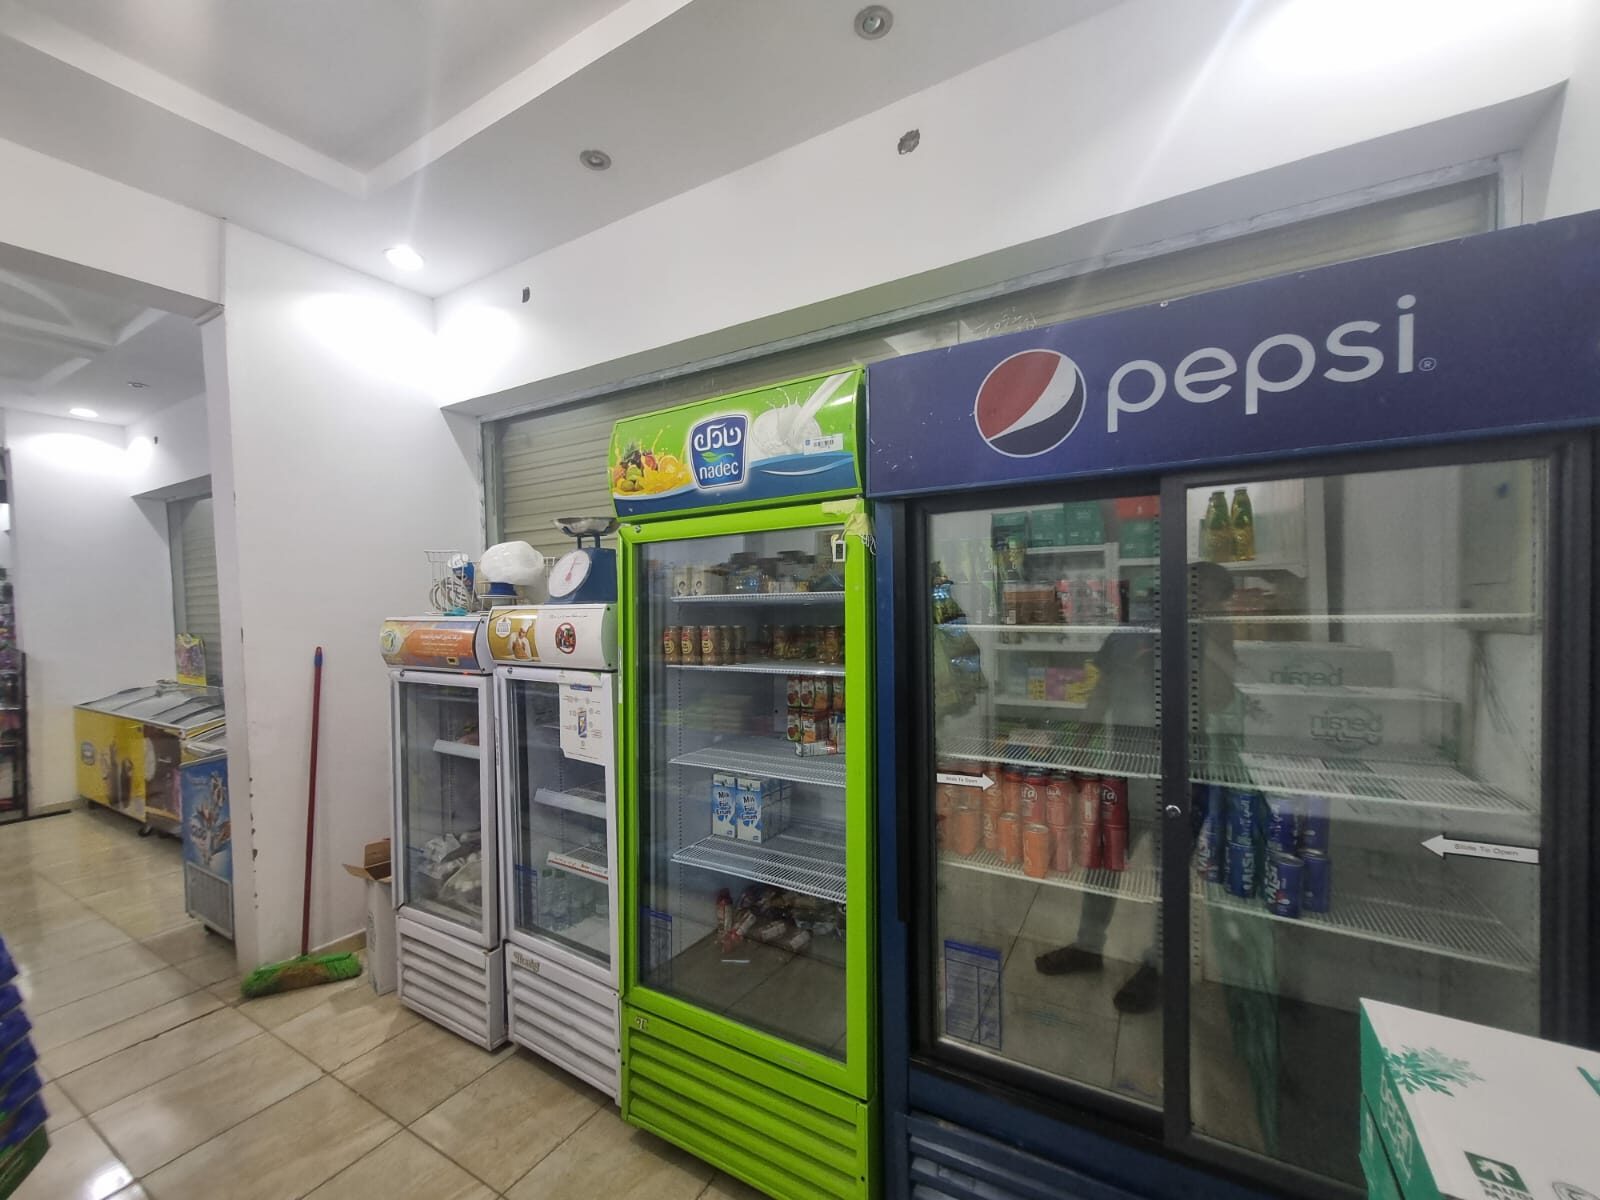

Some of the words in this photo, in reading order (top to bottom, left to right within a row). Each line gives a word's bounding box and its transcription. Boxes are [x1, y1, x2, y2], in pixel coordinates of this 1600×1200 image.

[1107, 294, 1417, 433] pepsi
[699, 459, 740, 481] nadec
[1455, 843, 1476, 852] Slide
[1480, 845, 1491, 853] To
[1493, 847, 1519, 857] Open
